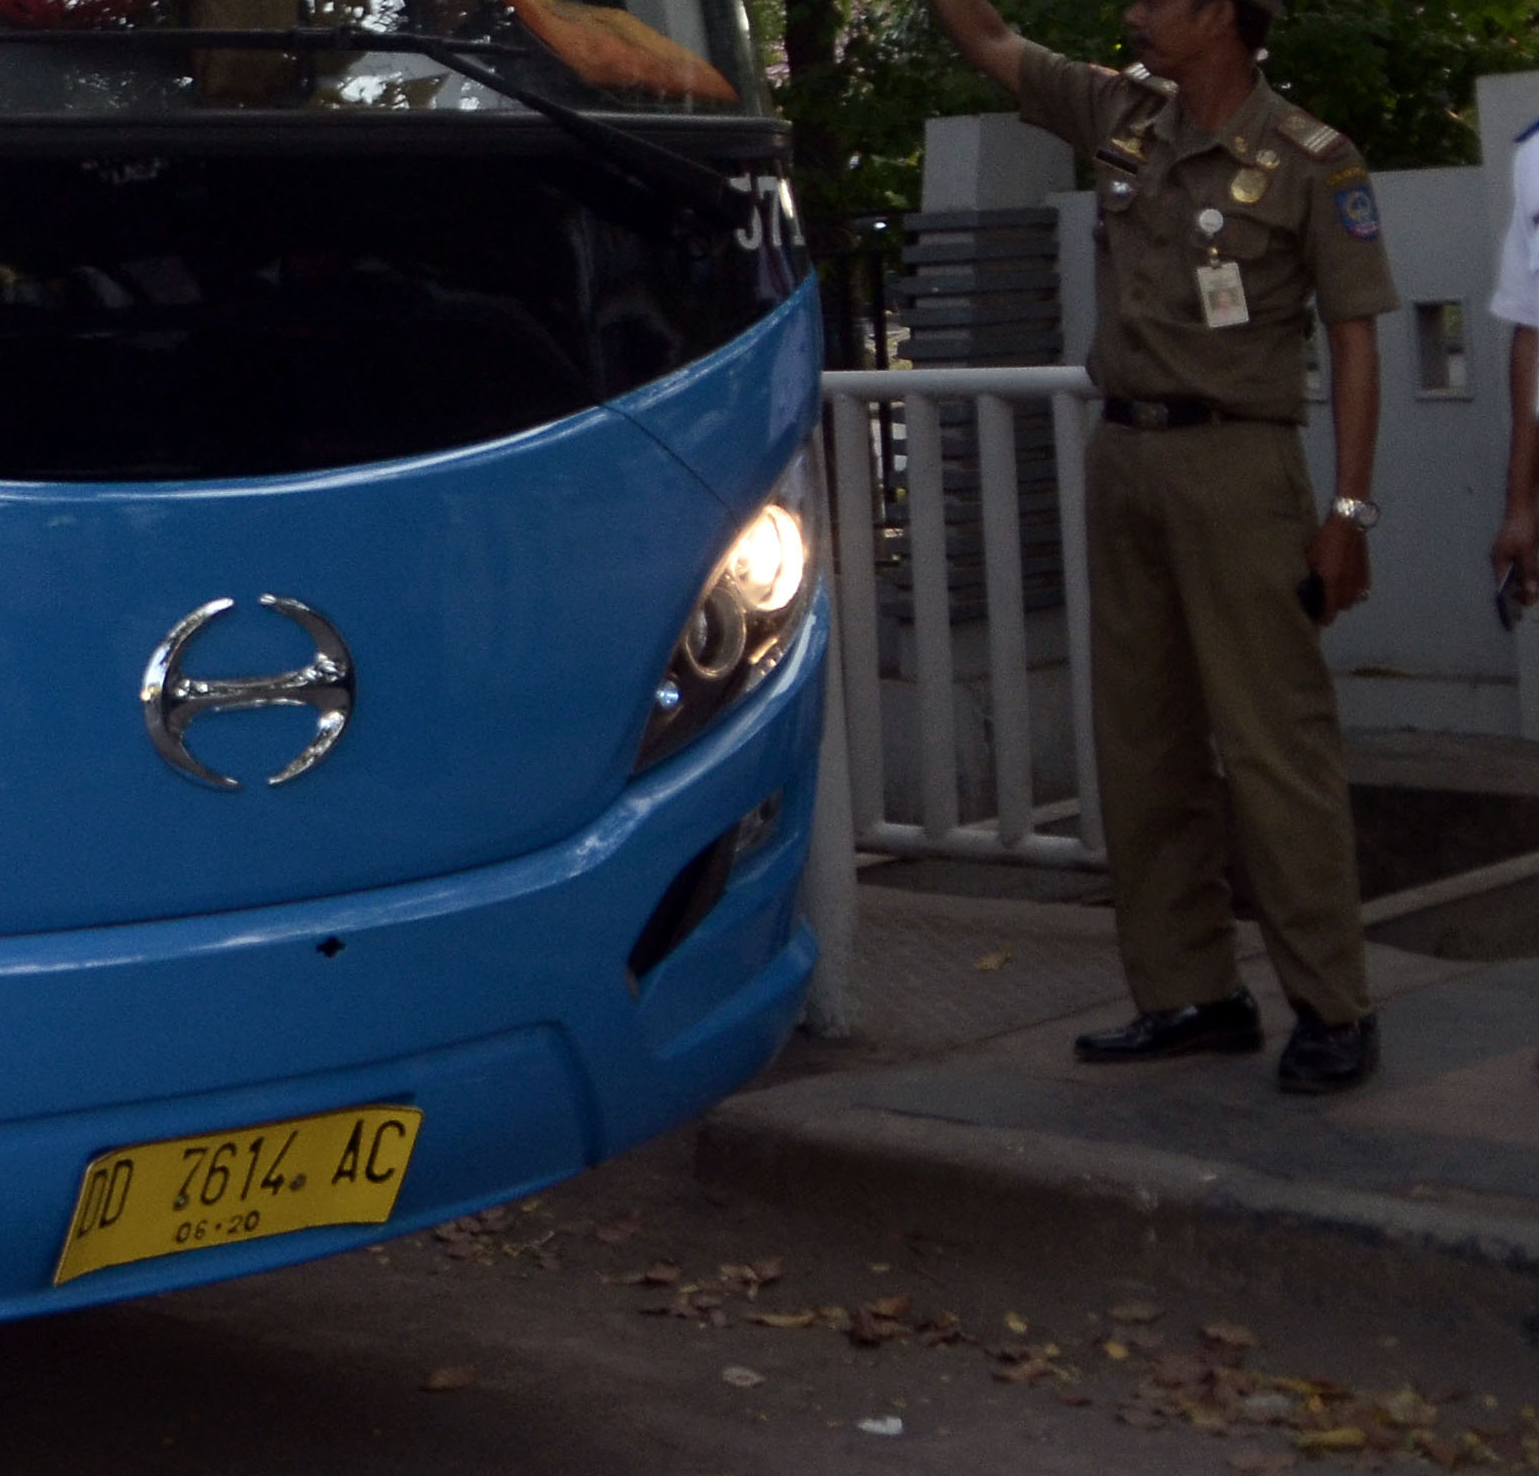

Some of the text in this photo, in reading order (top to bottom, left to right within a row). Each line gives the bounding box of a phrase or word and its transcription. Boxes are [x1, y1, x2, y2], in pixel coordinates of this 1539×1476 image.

[77, 1119, 407, 1240] DD 7614 AC
